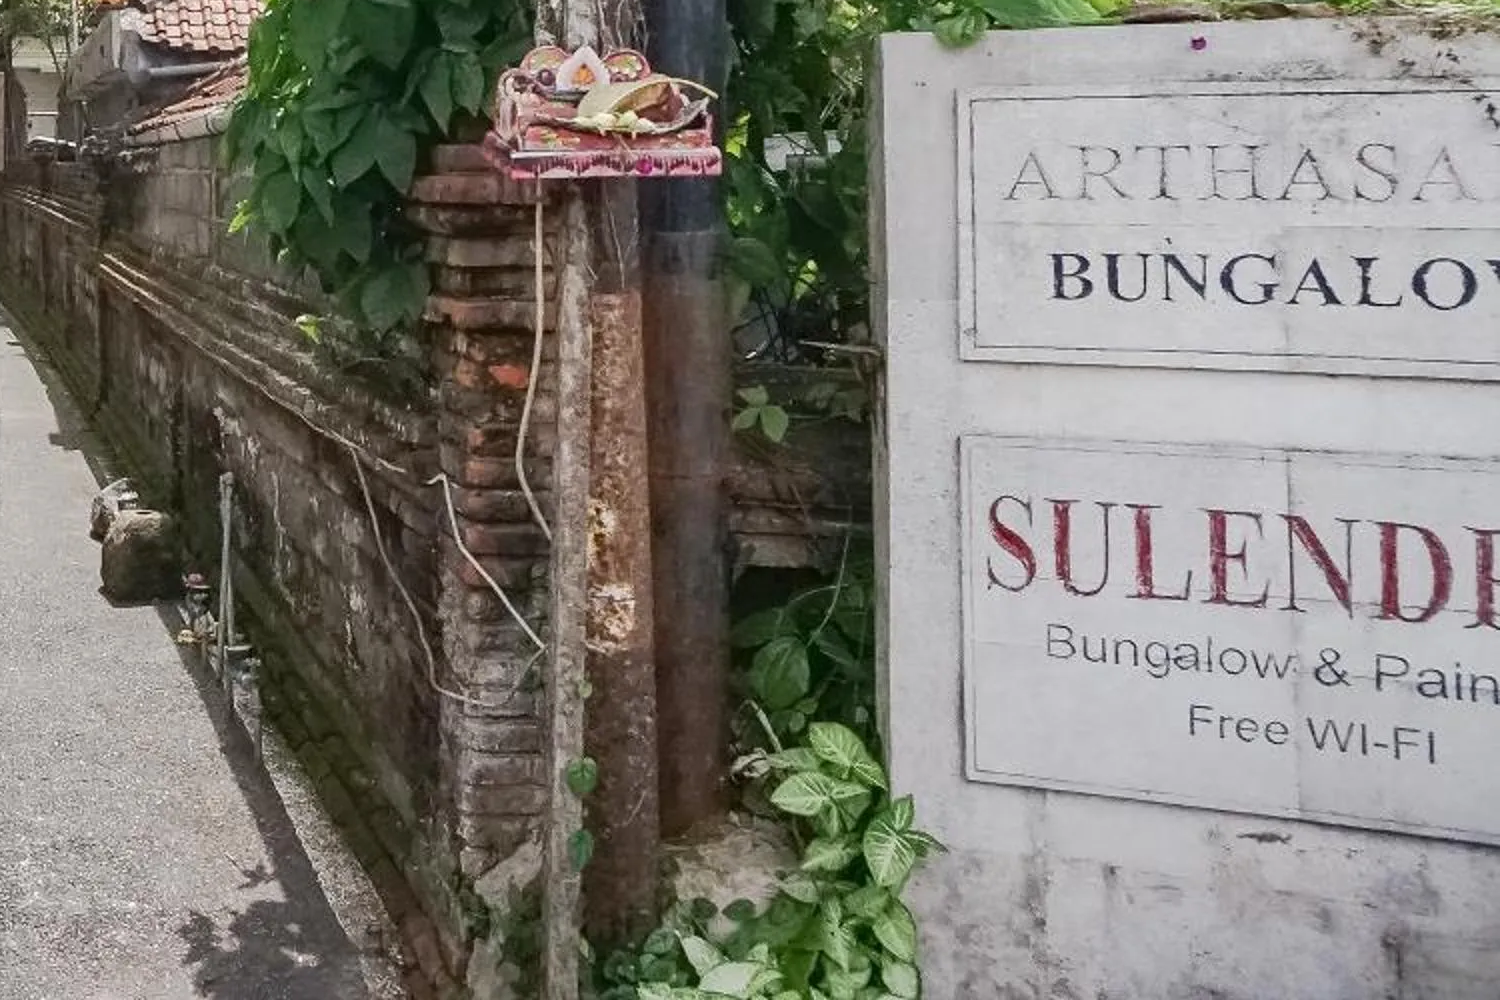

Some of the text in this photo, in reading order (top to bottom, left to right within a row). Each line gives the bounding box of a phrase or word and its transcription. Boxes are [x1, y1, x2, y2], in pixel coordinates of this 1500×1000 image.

[1002, 142, 1500, 203] ARTHASA
[1047, 251, 1500, 311] BUNGALO
[1046, 623, 1294, 679] Bungalow
[1313, 647, 1351, 688] &
[1188, 704, 1437, 765] Free WI-FI
